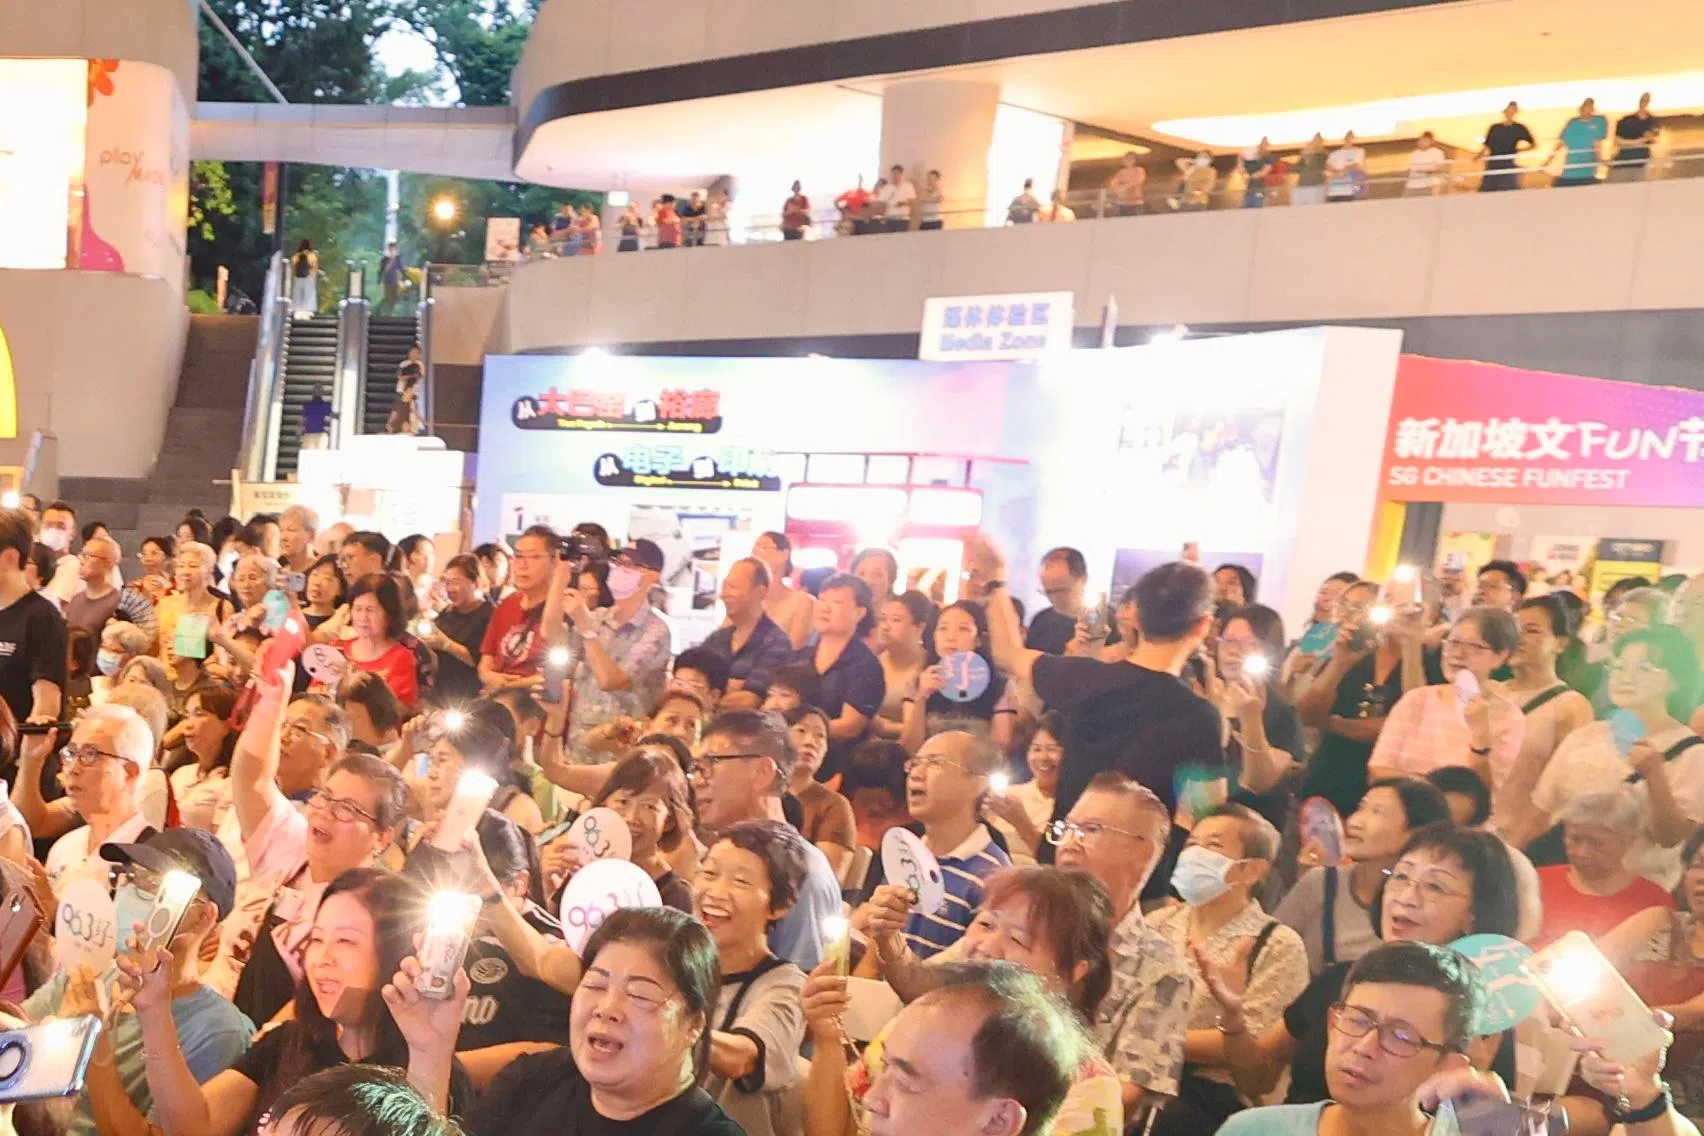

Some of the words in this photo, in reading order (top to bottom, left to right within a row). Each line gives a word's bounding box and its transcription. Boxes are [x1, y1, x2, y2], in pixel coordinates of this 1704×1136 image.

[1388, 466, 1419, 486] SG
[1422, 467, 1520, 488] CHINESE
[1522, 468, 1632, 490] FUNFEST
